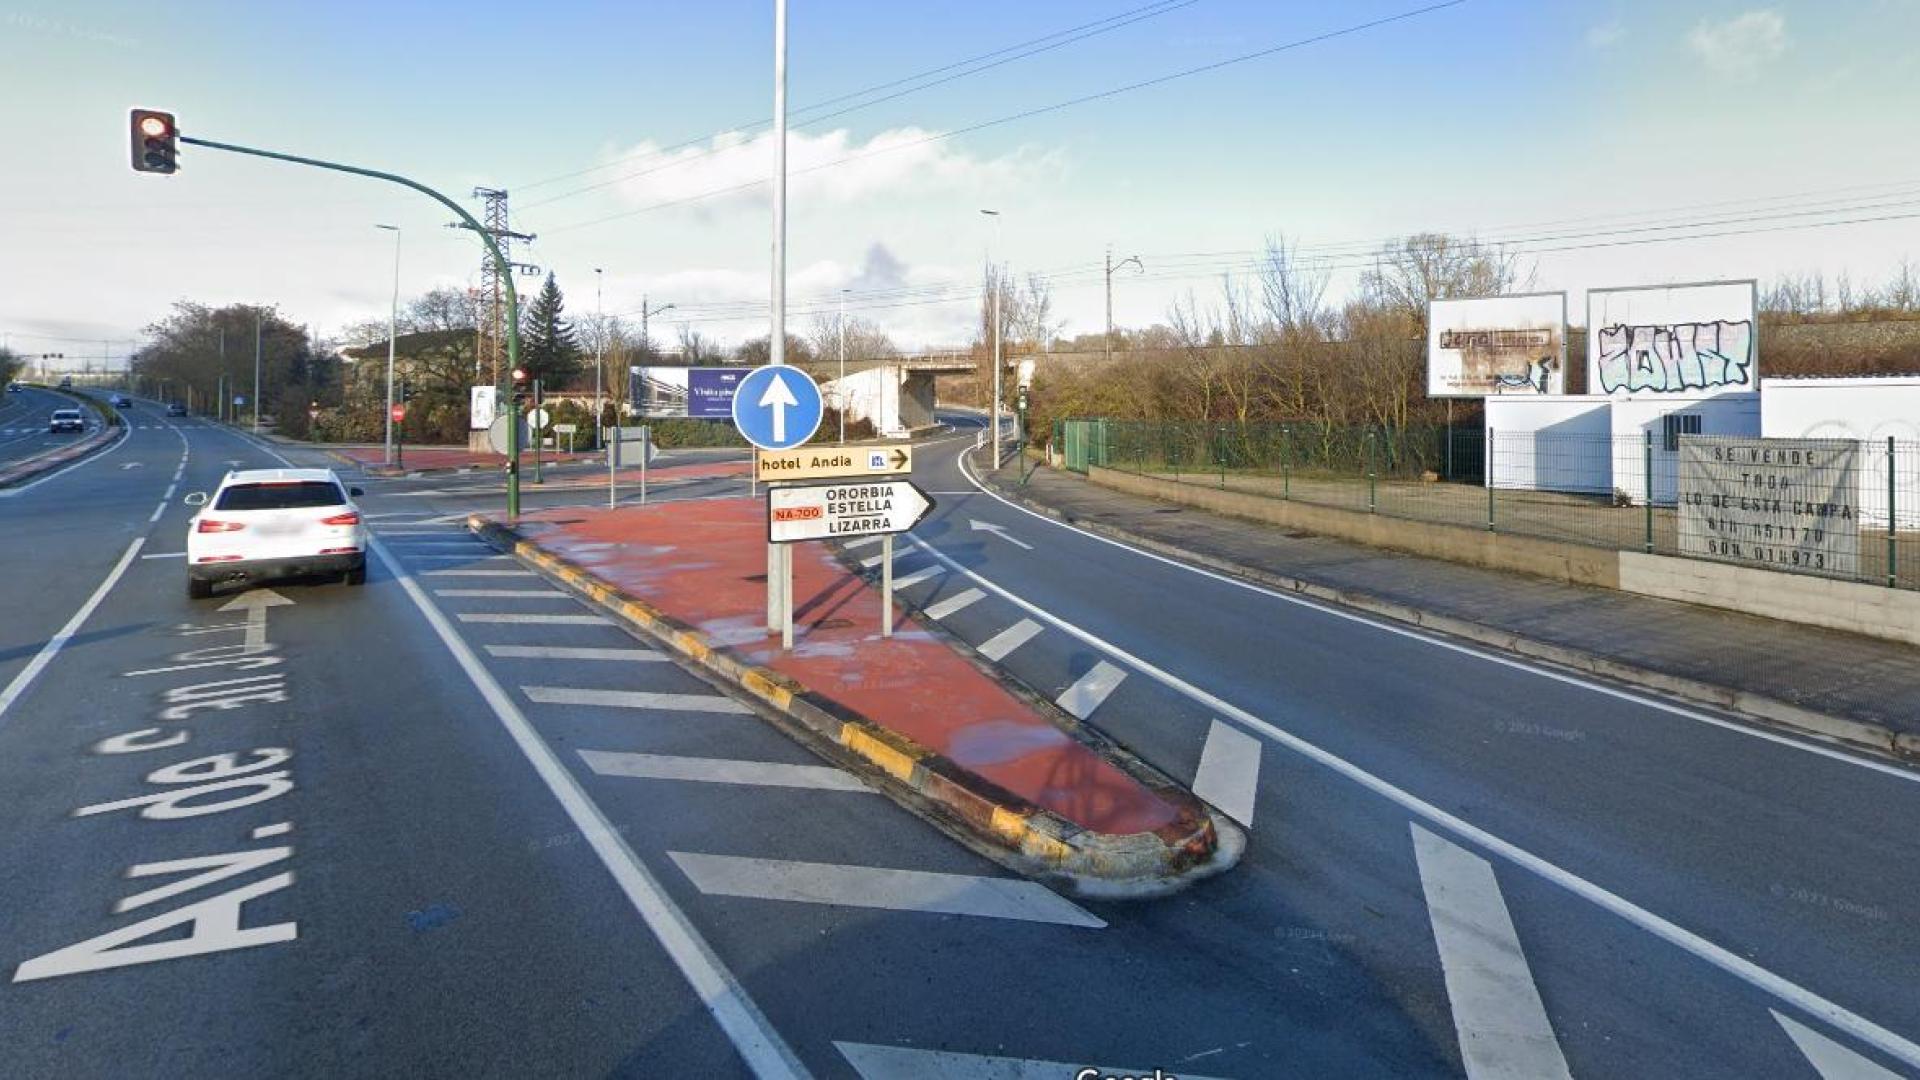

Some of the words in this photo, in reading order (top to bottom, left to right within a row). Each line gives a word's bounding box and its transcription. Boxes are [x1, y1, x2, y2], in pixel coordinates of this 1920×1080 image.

[762, 457, 801, 470] hotel
[811, 455, 852, 468] Andia
[1714, 447, 1734, 462] SE
[1751, 449, 1814, 465] VENDE
[826, 487, 894, 501] ORORBIA
[775, 508, 820, 520] NA-700
[828, 500, 893, 515] ESTELLA
[1741, 497, 1782, 514] ESTA
[1793, 501, 1852, 520] CAMPA
[829, 518, 891, 534] LIZARRA
[75, 746, 294, 820] de
[12, 822, 298, 983] Av.
